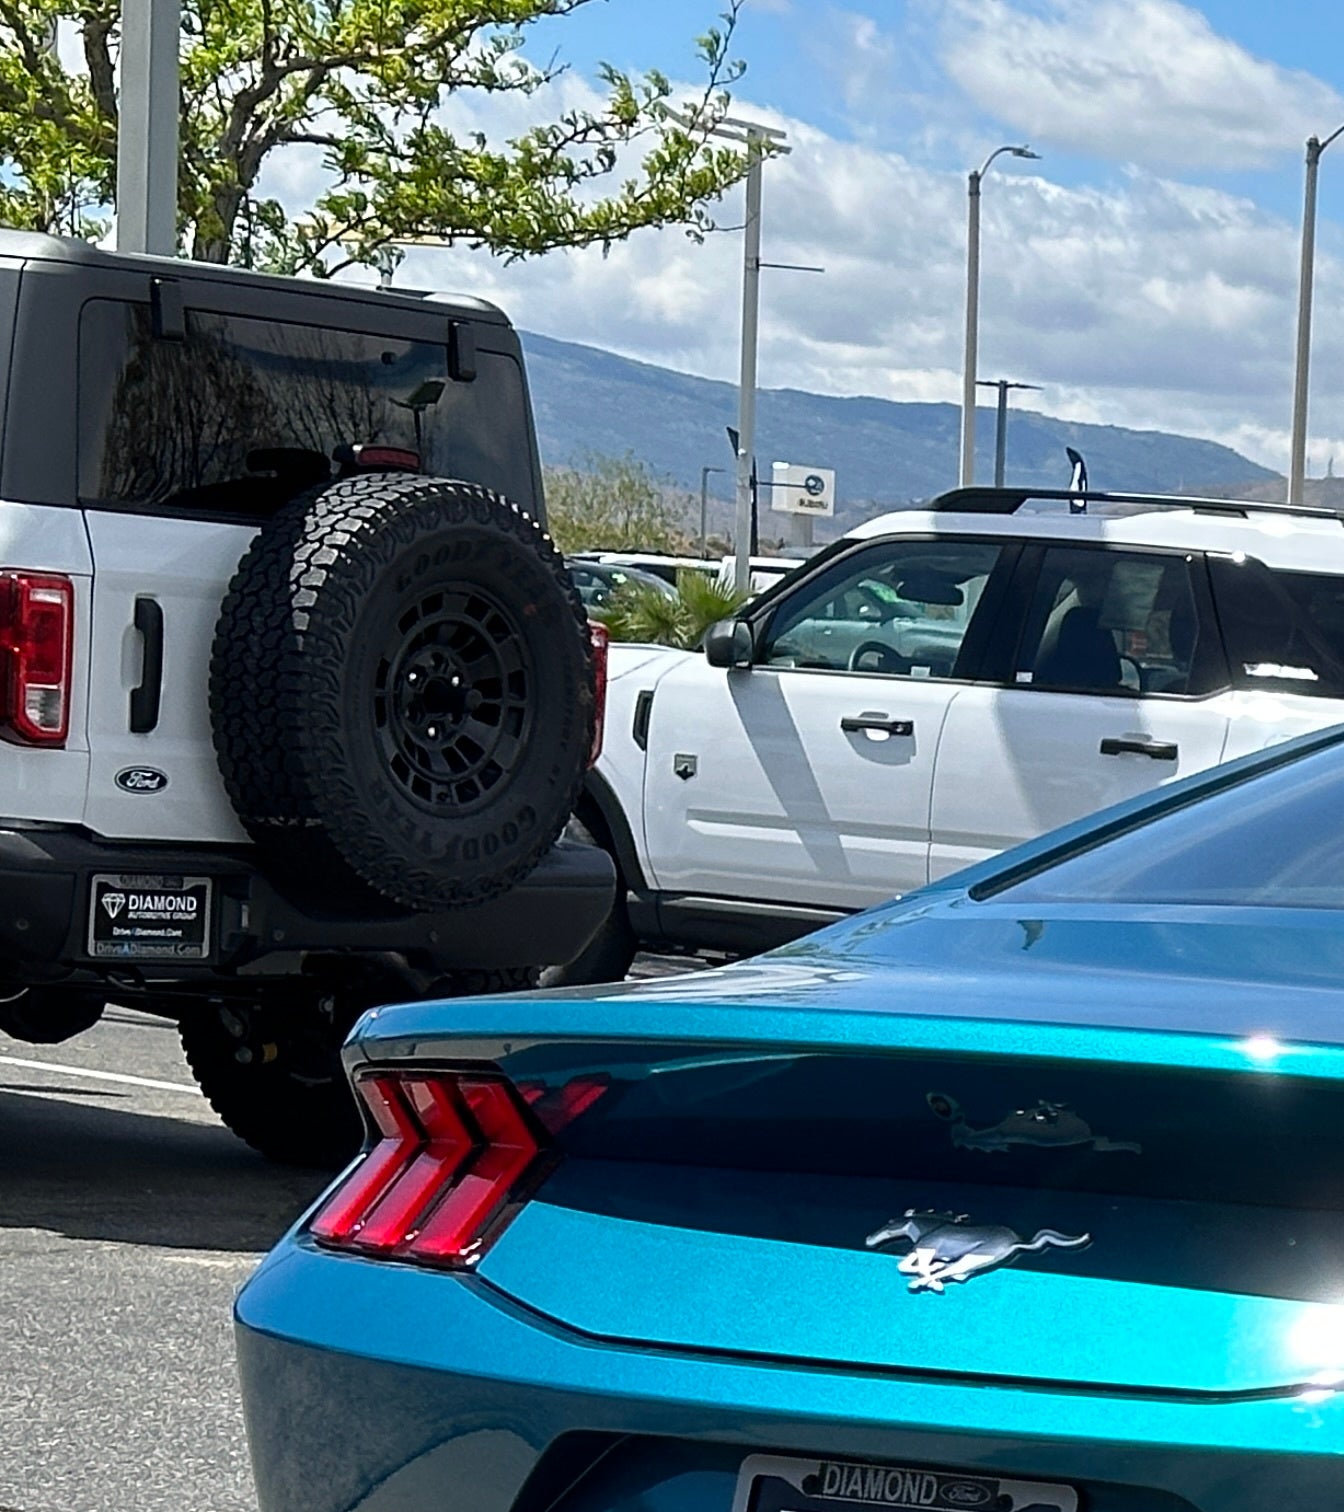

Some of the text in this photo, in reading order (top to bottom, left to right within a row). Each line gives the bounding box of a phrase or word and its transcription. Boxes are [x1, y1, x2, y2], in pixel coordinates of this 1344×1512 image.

[126, 771, 161, 788] Ford
[128, 894, 197, 912] DIAMOND
[823, 1464, 938, 1506] DIAMOND
